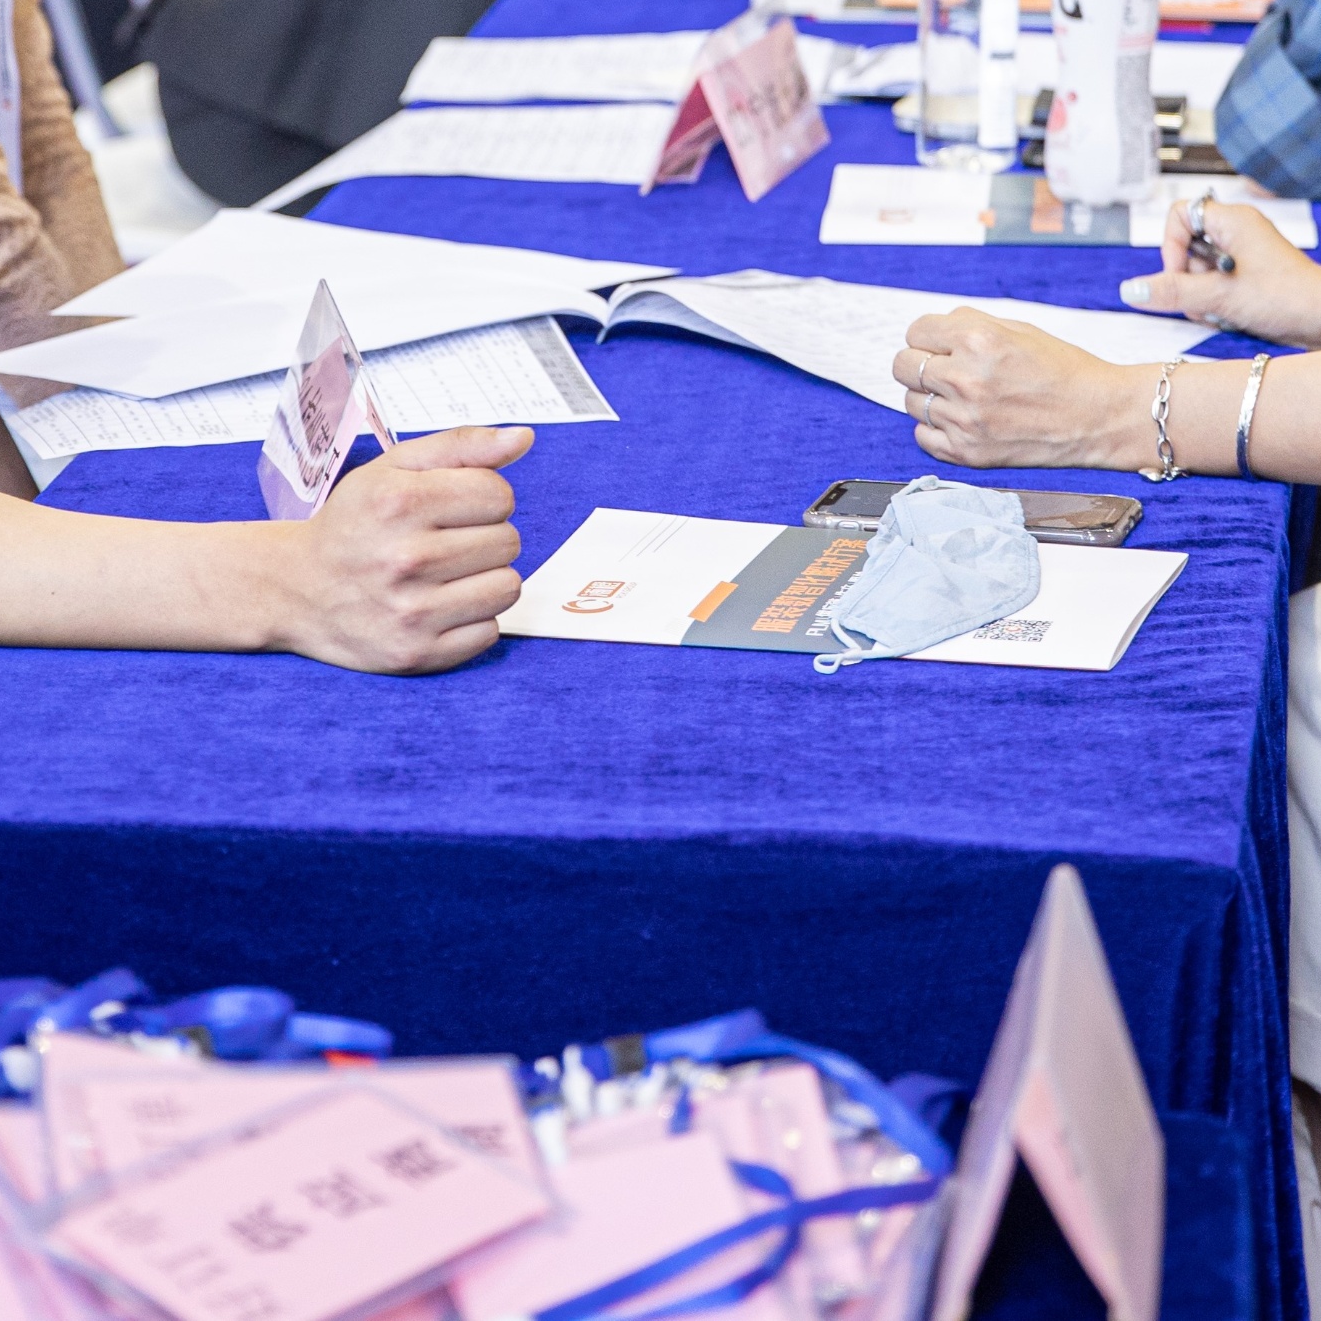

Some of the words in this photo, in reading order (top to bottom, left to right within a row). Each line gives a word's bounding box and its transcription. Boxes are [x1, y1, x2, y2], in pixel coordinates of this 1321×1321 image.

[751, 537, 868, 634] 服装数智化解决方案
